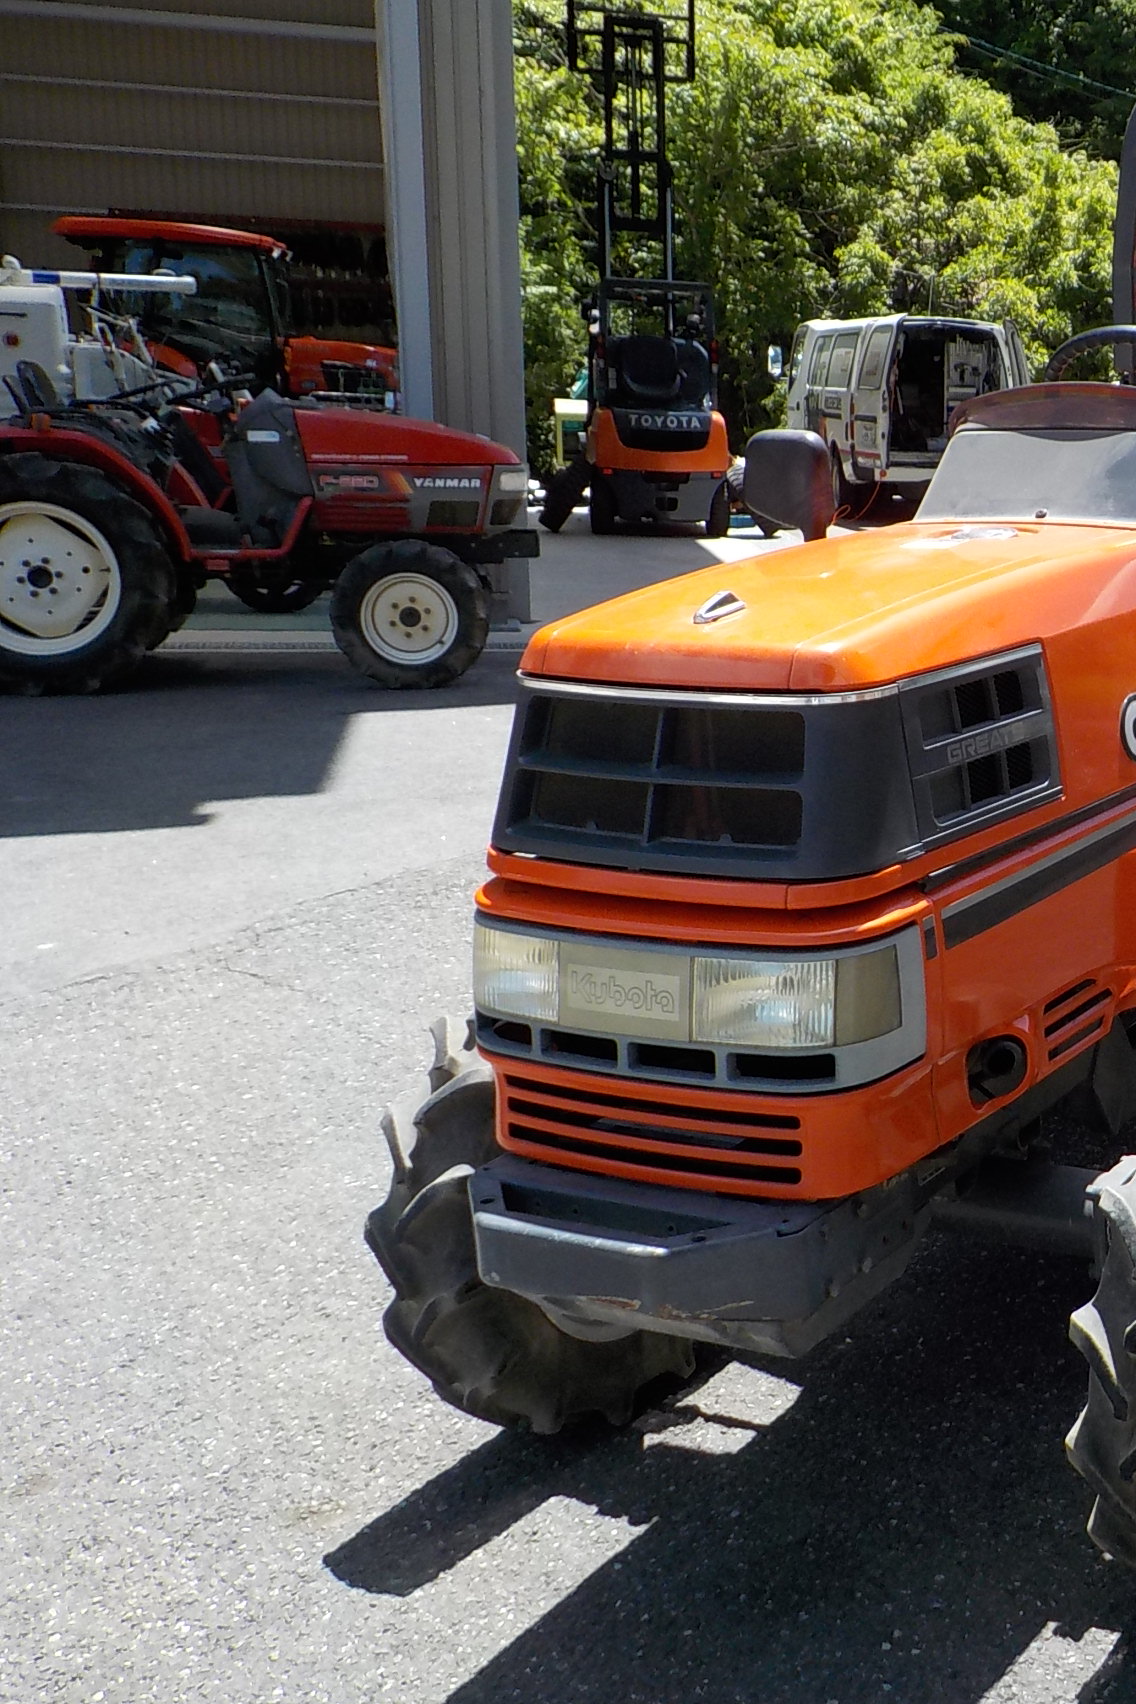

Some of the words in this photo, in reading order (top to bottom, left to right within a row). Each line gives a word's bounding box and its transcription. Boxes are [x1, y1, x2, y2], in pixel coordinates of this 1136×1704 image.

[629, 414, 701, 428] TOYOTA
[413, 478, 481, 488] YANMAR
[571, 970, 675, 1014] Kubota
